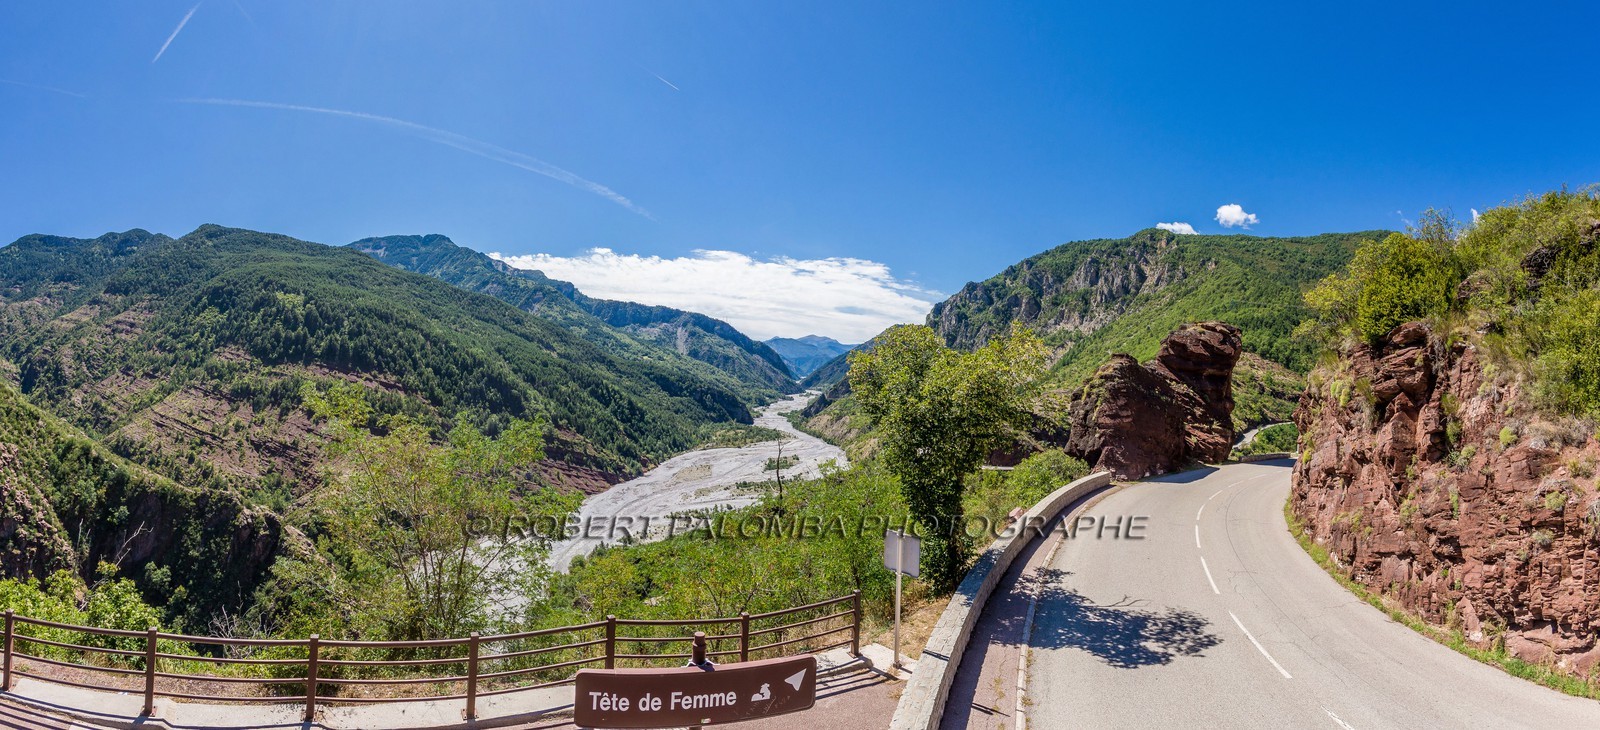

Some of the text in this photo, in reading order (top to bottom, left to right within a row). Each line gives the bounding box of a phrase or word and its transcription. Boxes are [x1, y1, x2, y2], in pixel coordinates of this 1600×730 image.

[589, 691, 737, 711] Tête de Femme
